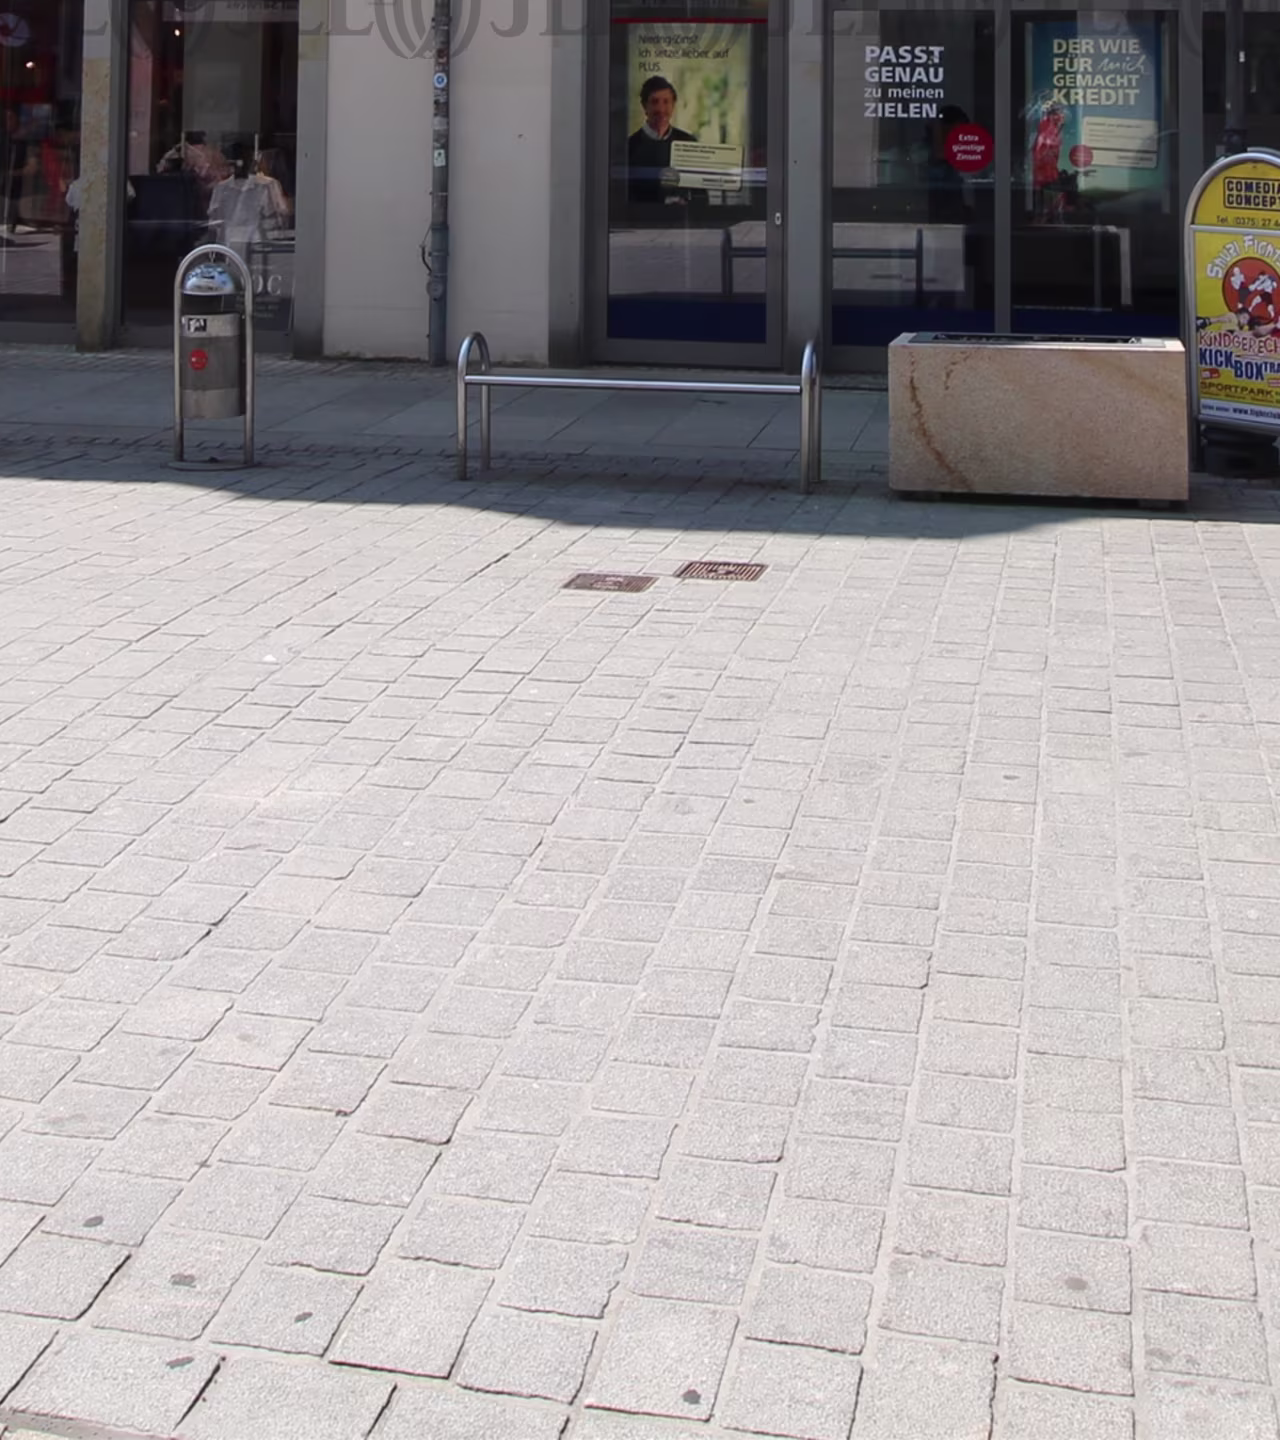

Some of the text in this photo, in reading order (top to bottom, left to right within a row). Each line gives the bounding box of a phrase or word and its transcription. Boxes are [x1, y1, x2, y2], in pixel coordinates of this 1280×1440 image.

[864, 45, 945, 64] PASST
[1052, 38, 1141, 54] DER WIE
[1052, 54, 1093, 72] FÜR
[864, 65, 944, 83] GENAU
[1052, 74, 1141, 88] GEMACHT
[863, 84, 944, 99] zu meinen
[1053, 88, 1141, 106] KREDIT
[863, 101, 944, 119] ZIELEN.
[1199, 348, 1234, 369] KICK
[1234, 360, 1264, 381] BOX
[1200, 380, 1274, 398] SPORTPARK
